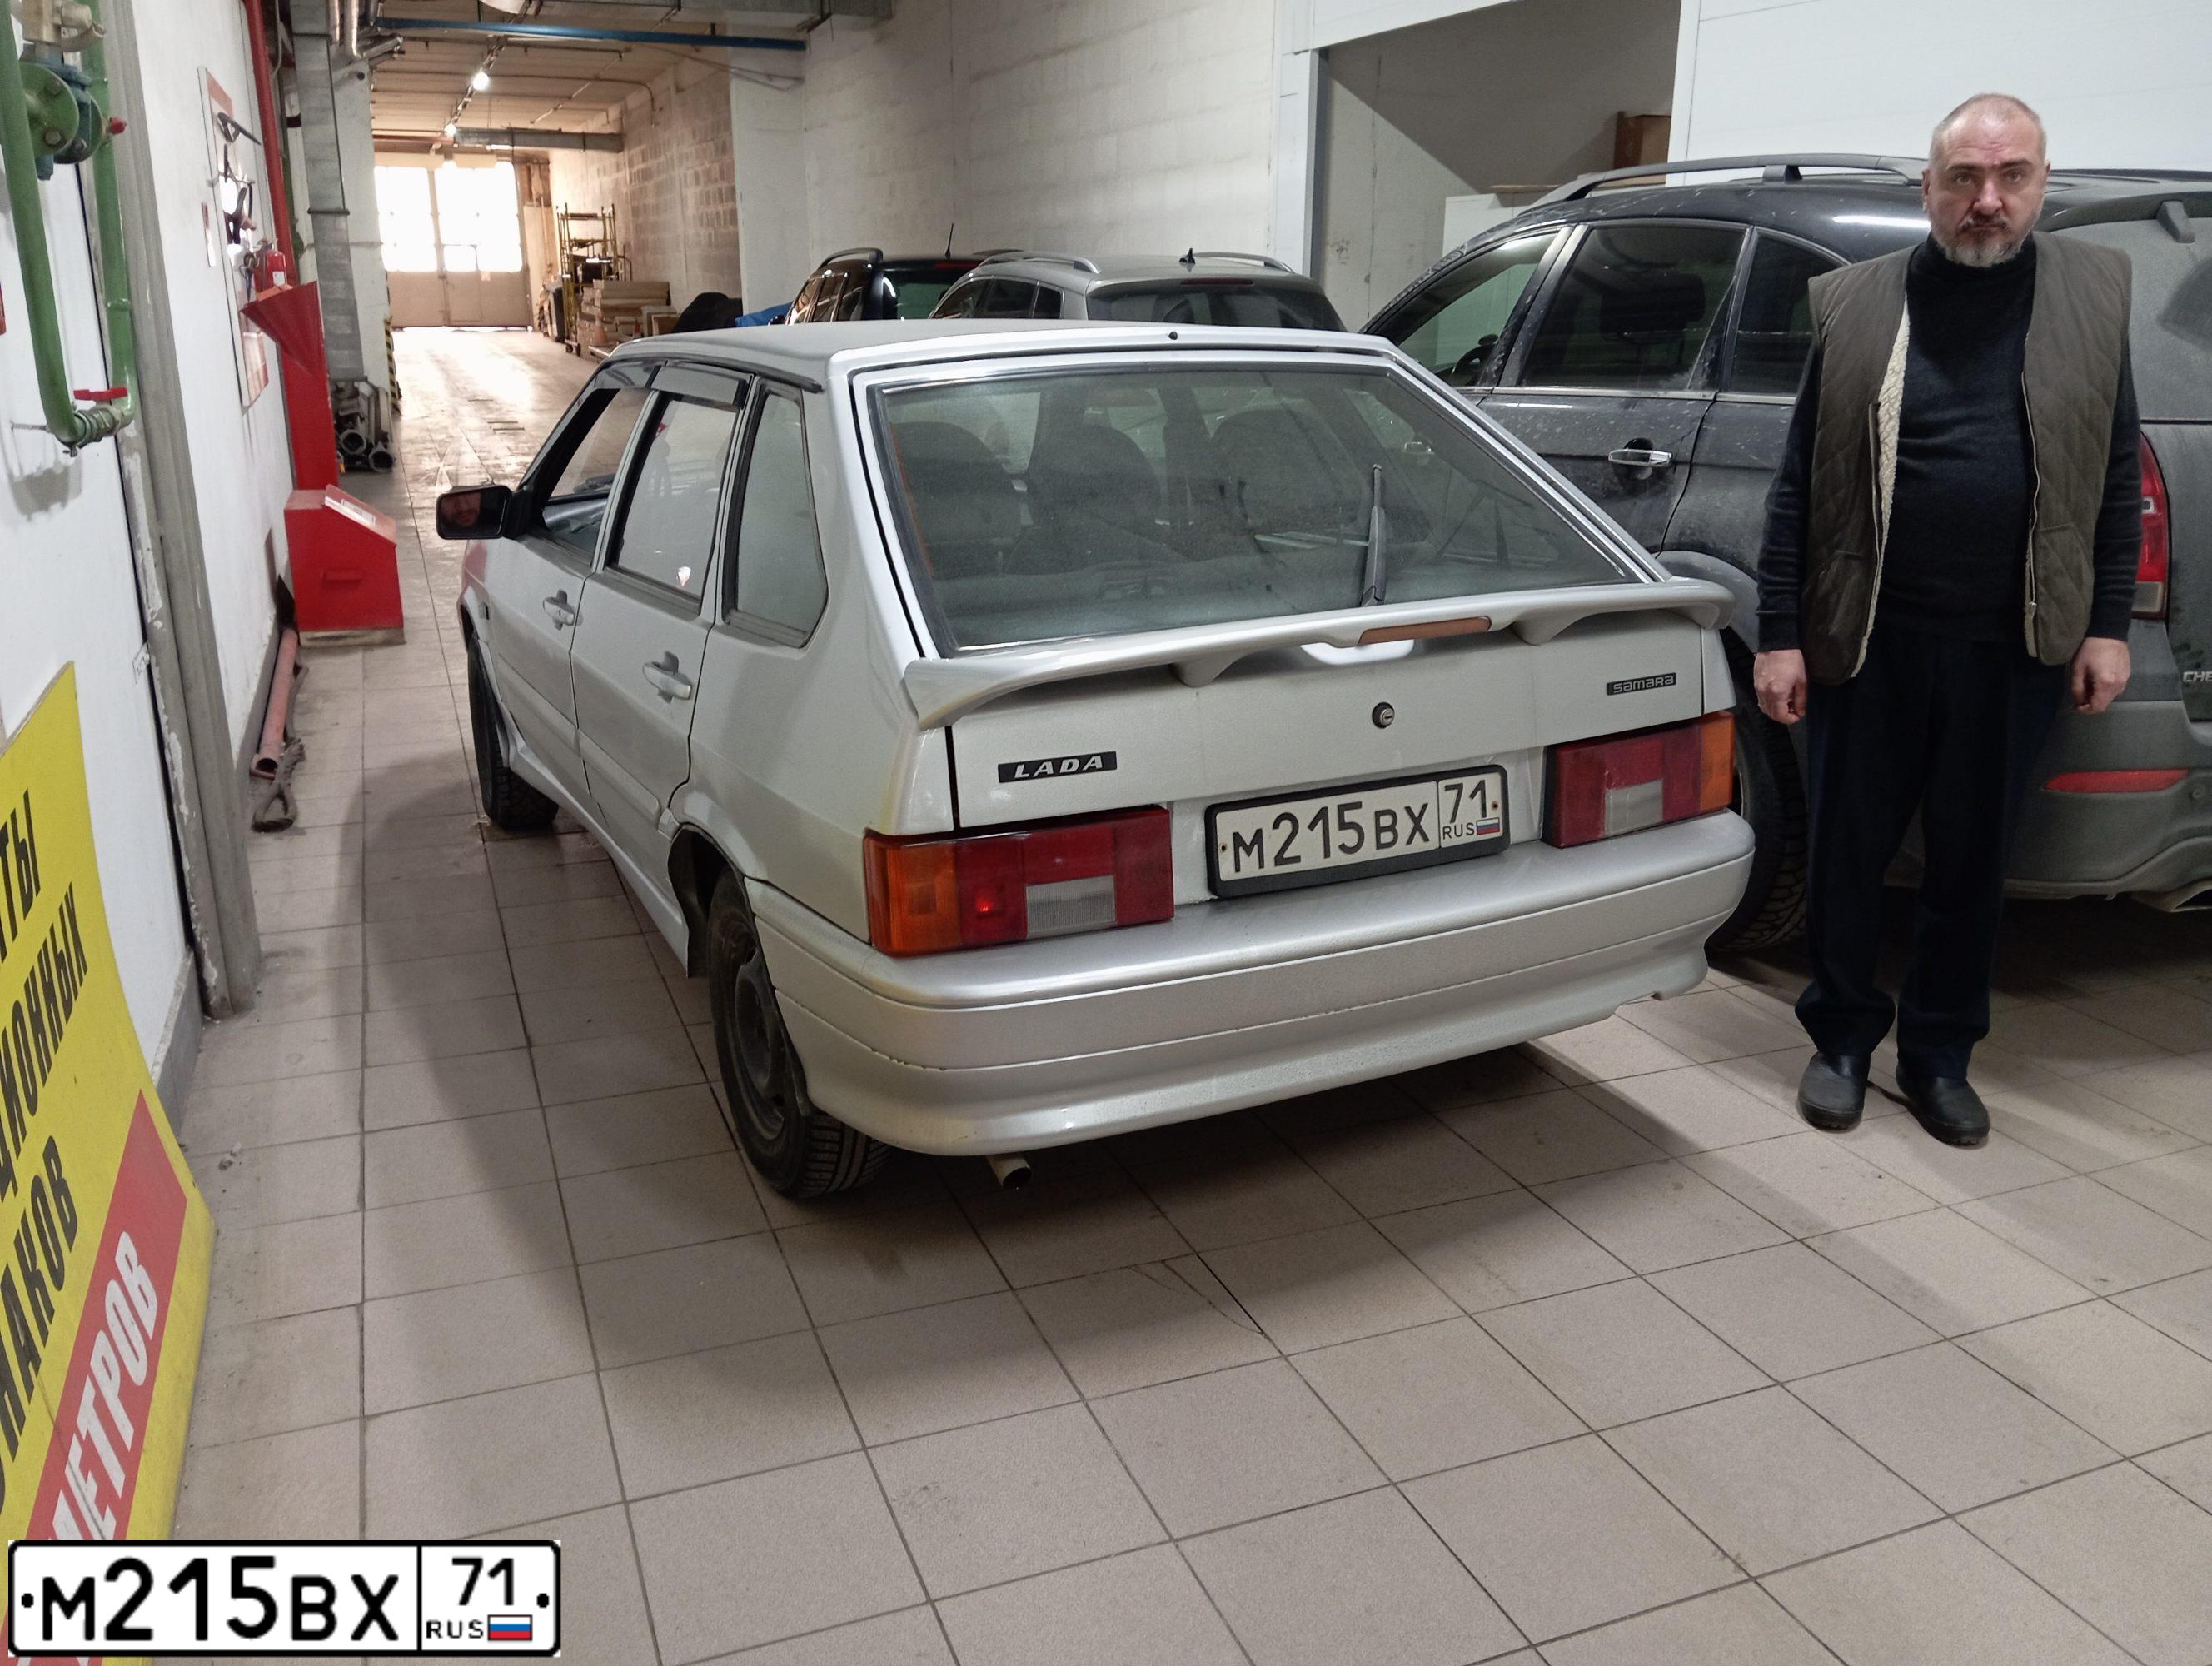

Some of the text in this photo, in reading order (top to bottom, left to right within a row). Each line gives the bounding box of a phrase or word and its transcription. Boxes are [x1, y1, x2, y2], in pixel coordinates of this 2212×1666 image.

[1014, 755, 1104, 780] LADA
[1444, 779, 1488, 824] 71
[1442, 822, 1475, 840] RUS
[0, 787, 41, 965] ТЫ
[0, 1135, 78, 1518] НАКОВ
